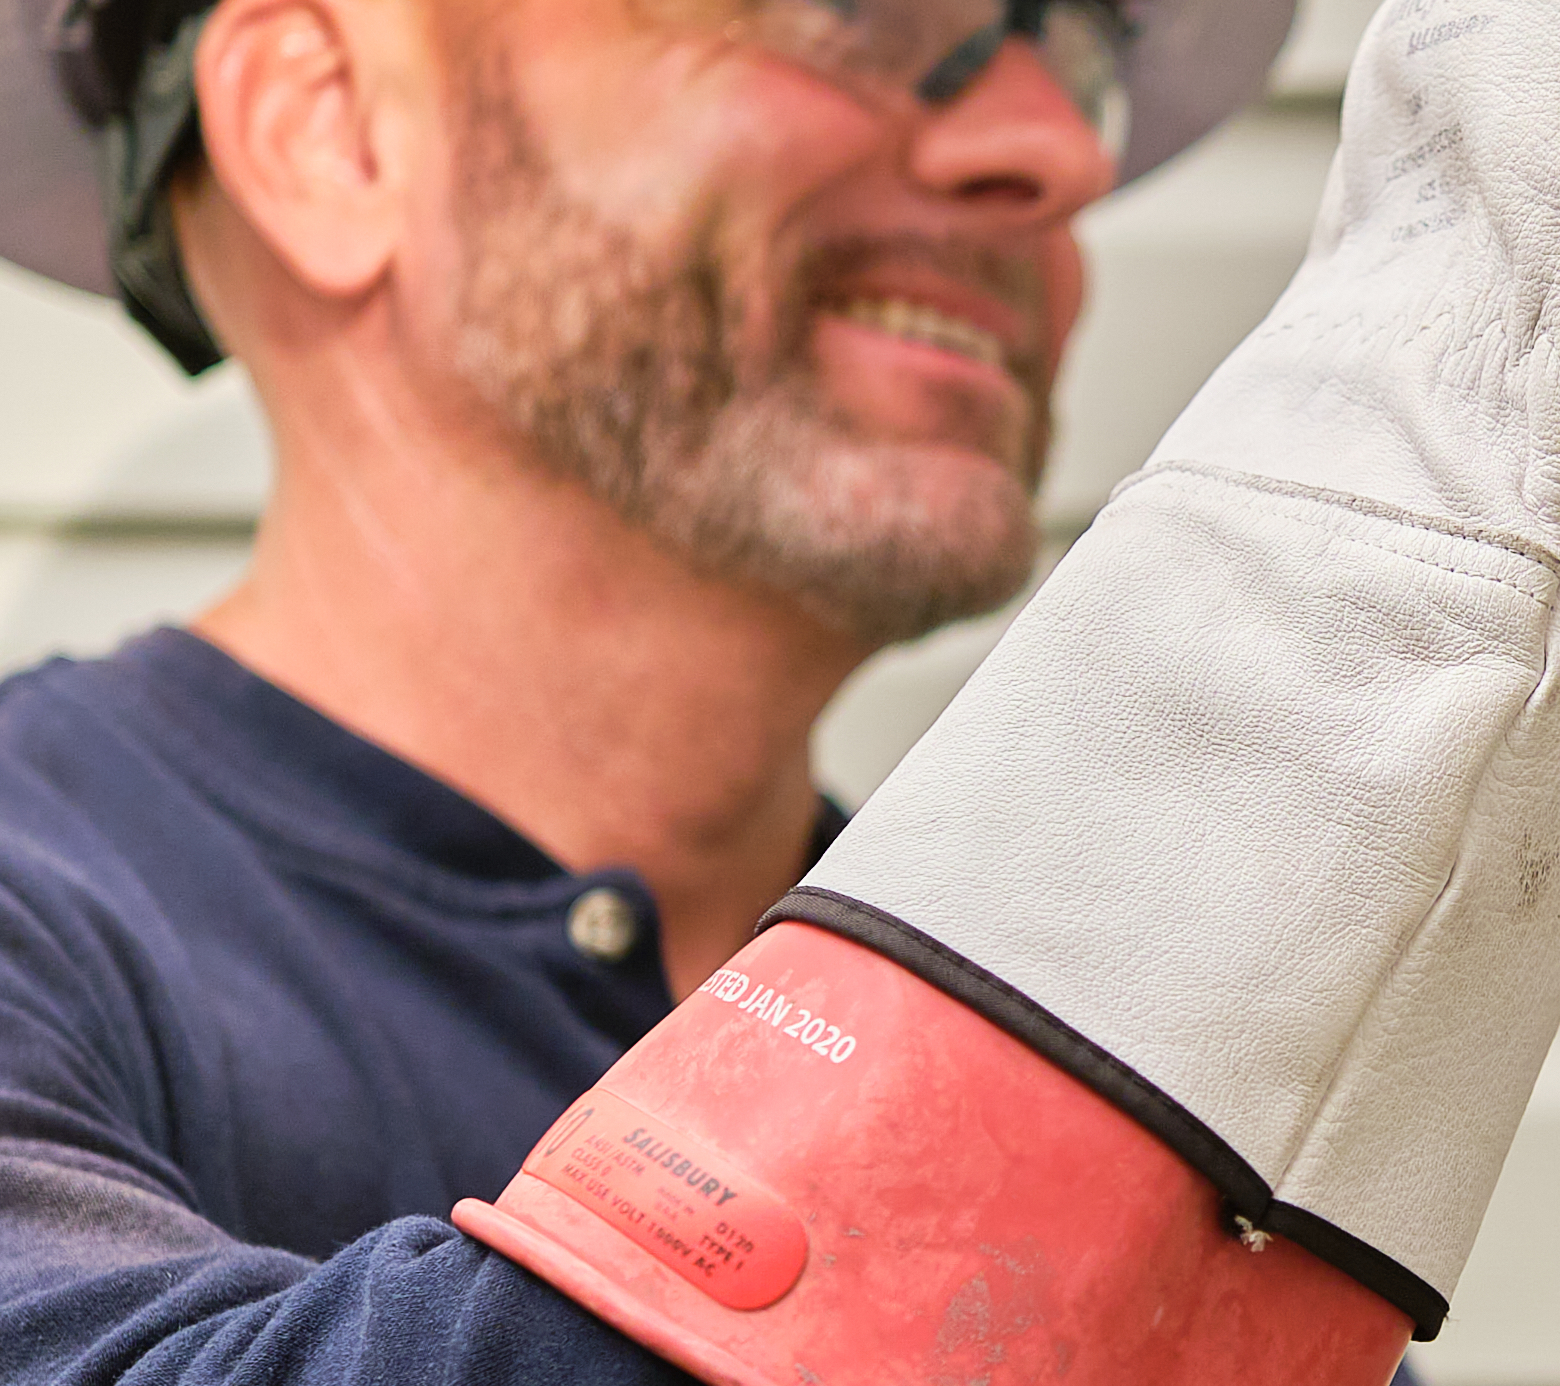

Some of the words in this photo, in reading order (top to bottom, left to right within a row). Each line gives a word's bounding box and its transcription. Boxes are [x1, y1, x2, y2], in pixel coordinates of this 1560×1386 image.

[737, 983, 794, 1027] JAN
[783, 1008, 857, 1065] 2020
[561, 1162, 588, 1184] MAX
[585, 1177, 611, 1201] USE
[611, 1194, 646, 1225] VOLT
[571, 1147, 604, 1173] CLASS
[622, 1126, 738, 1207] SALISBURY
